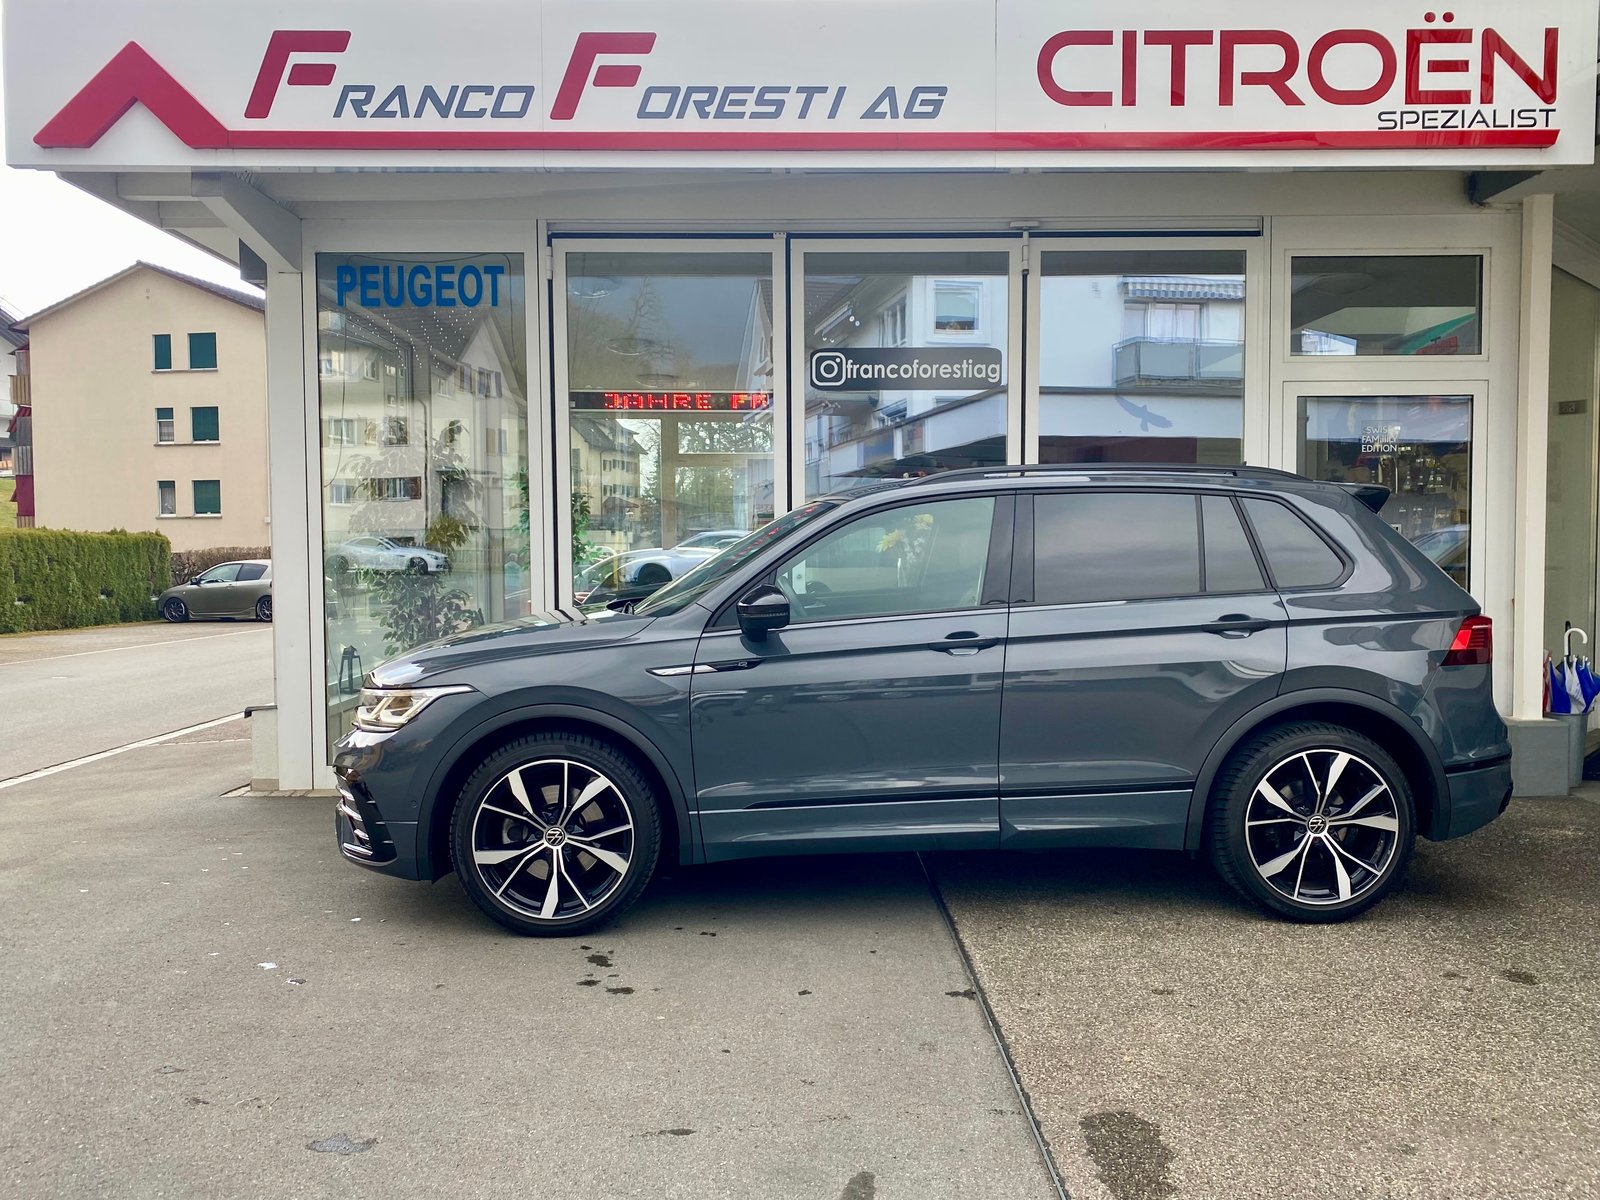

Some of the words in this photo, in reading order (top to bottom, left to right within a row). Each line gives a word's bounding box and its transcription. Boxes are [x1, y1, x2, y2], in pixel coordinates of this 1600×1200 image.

[1037, 12, 1559, 106] CITROËN
[244, 30, 535, 119] FRANCO
[550, 32, 846, 119] FORESTI
[860, 86, 948, 119] AG
[1378, 109, 1556, 130] SPEZIALIST
[336, 265, 505, 307] PEUGEOT
[845, 359, 1001, 382] francoforestiag
[604, 393, 711, 409] JAHRE
[1366, 426, 1394, 434] SWIS
[1361, 444, 1397, 453] EDITION
